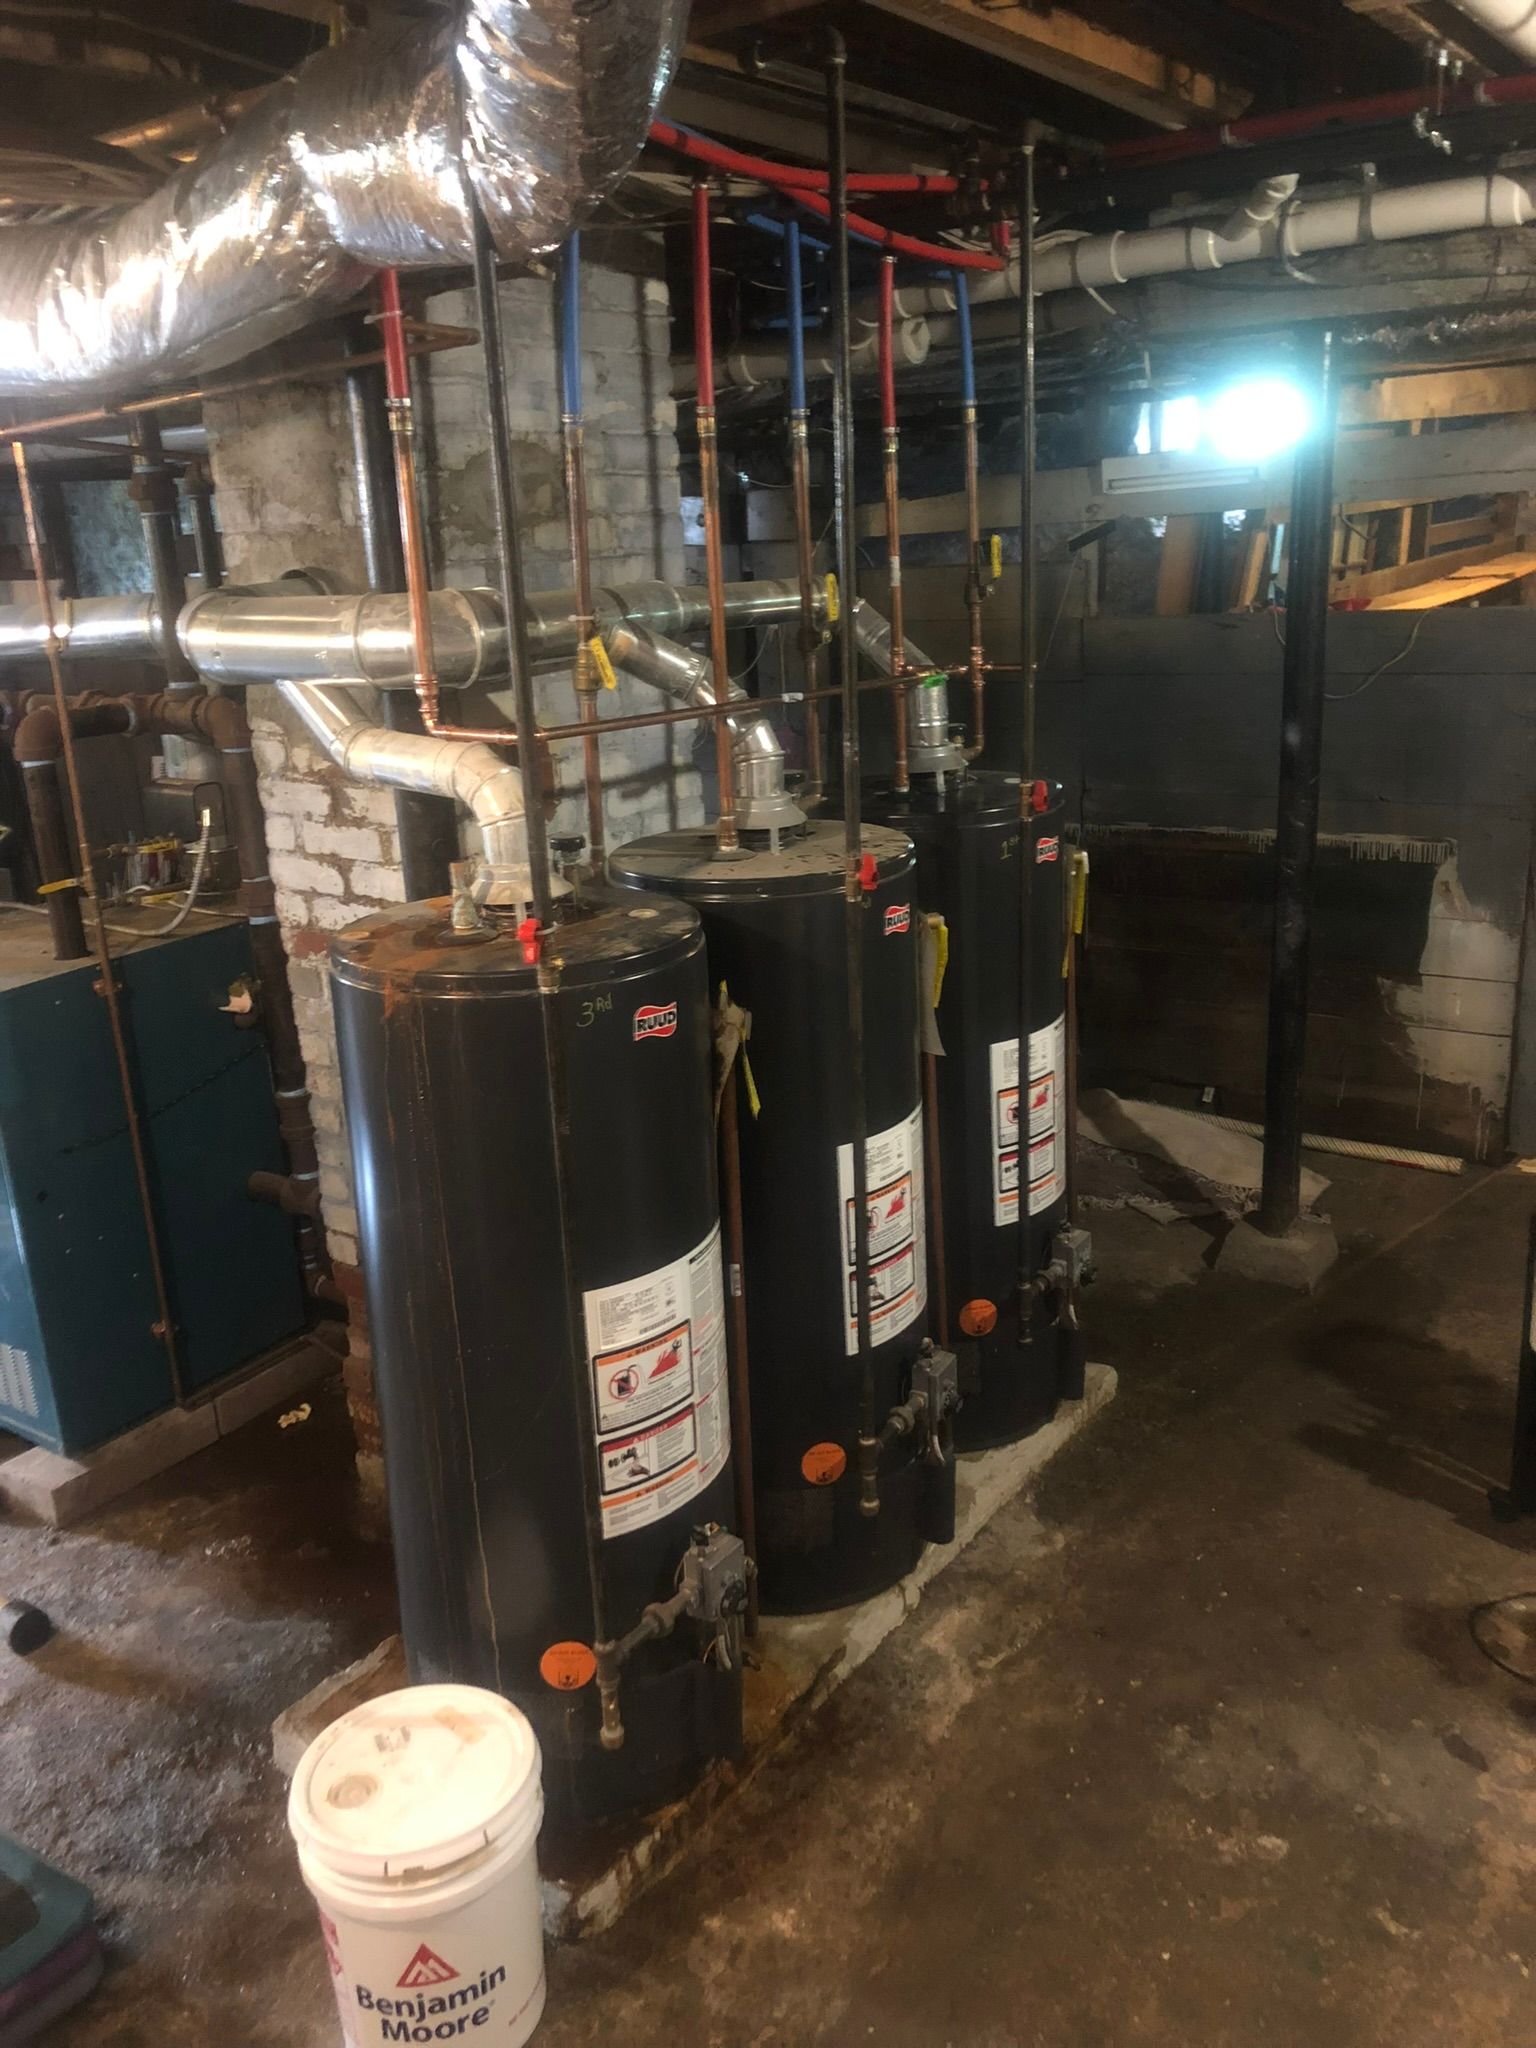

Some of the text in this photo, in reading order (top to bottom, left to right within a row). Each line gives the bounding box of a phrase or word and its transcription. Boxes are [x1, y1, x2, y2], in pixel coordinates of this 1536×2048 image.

[636, 1009, 676, 1034] RUUD
[356, 1964, 507, 2024] Benjamin
[381, 2003, 491, 2044] Moore
